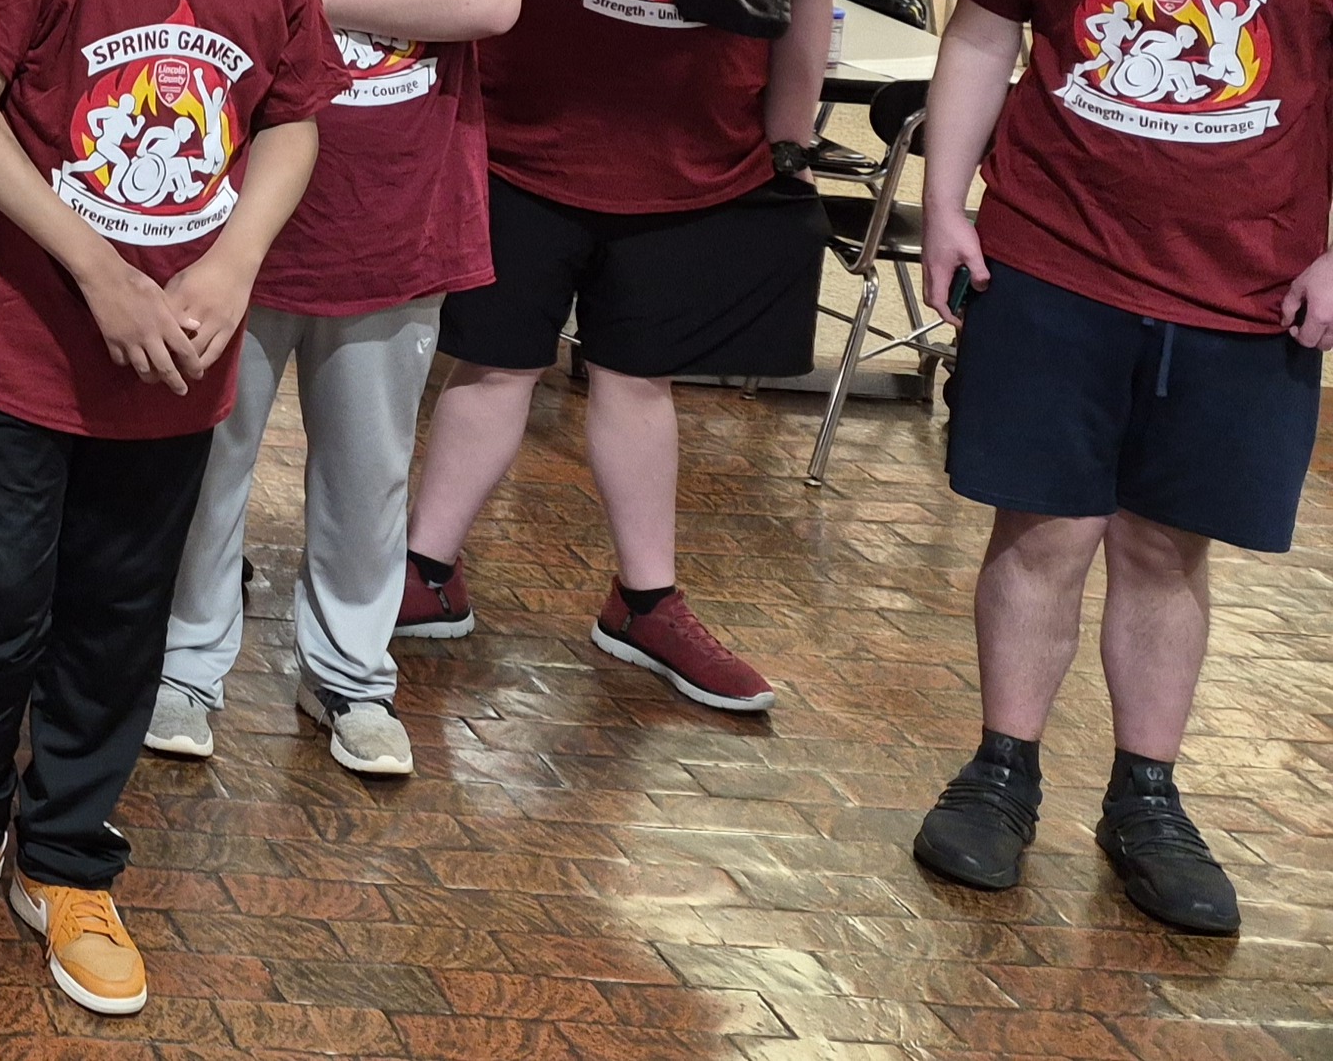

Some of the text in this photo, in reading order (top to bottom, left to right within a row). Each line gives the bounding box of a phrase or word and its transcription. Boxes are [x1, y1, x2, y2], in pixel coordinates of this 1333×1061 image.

[658, 8, 682, 21] Uni
[92, 29, 244, 72] SPRING GAMES
[158, 64, 186, 75] Lincoln
[158, 74, 187, 85] County
[372, 80, 419, 98] Courage
[1072, 94, 1255, 135] Strength Unity Courage
[70, 197, 229, 238] Strength Unity Courage
